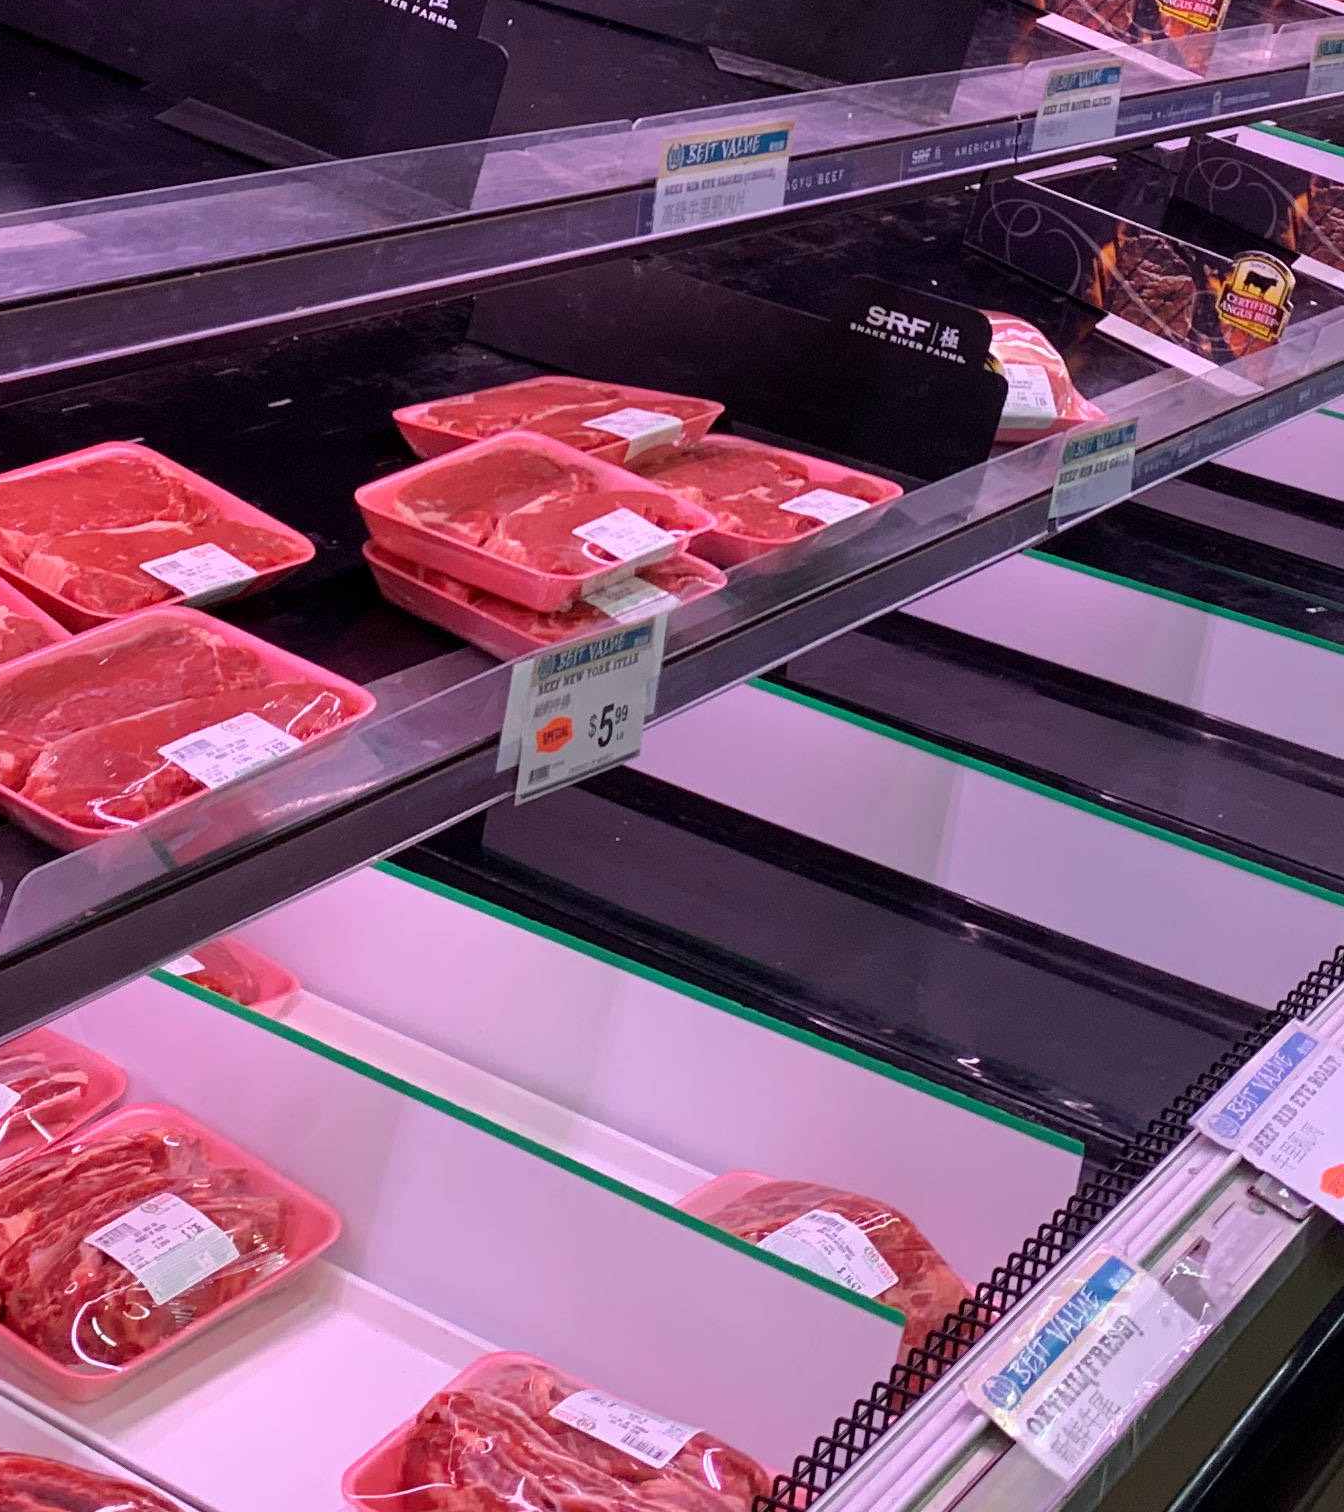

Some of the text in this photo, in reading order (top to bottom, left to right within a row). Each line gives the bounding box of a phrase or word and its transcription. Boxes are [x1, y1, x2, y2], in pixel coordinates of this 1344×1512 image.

[686, 135, 760, 164] BEST VALUE
[955, 140, 1001, 156] AMERICAN
[817, 169, 845, 186] BEEF
[1220, 301, 1254, 321] ANGUS
[1226, 292, 1277, 316] CERTIFIED
[866, 305, 931, 338] SRF
[849, 322, 887, 341] SNAKE
[890, 334, 923, 351] RIVER
[538, 654, 639, 696] BEEF NEW YORK STEAK
[1226, 1050, 1292, 1121] BEST VALUE
[1247, 1055, 1343, 1157] BEEF RIB EYE ROAST
[1007, 1283, 1101, 1386] BEST VALUE
